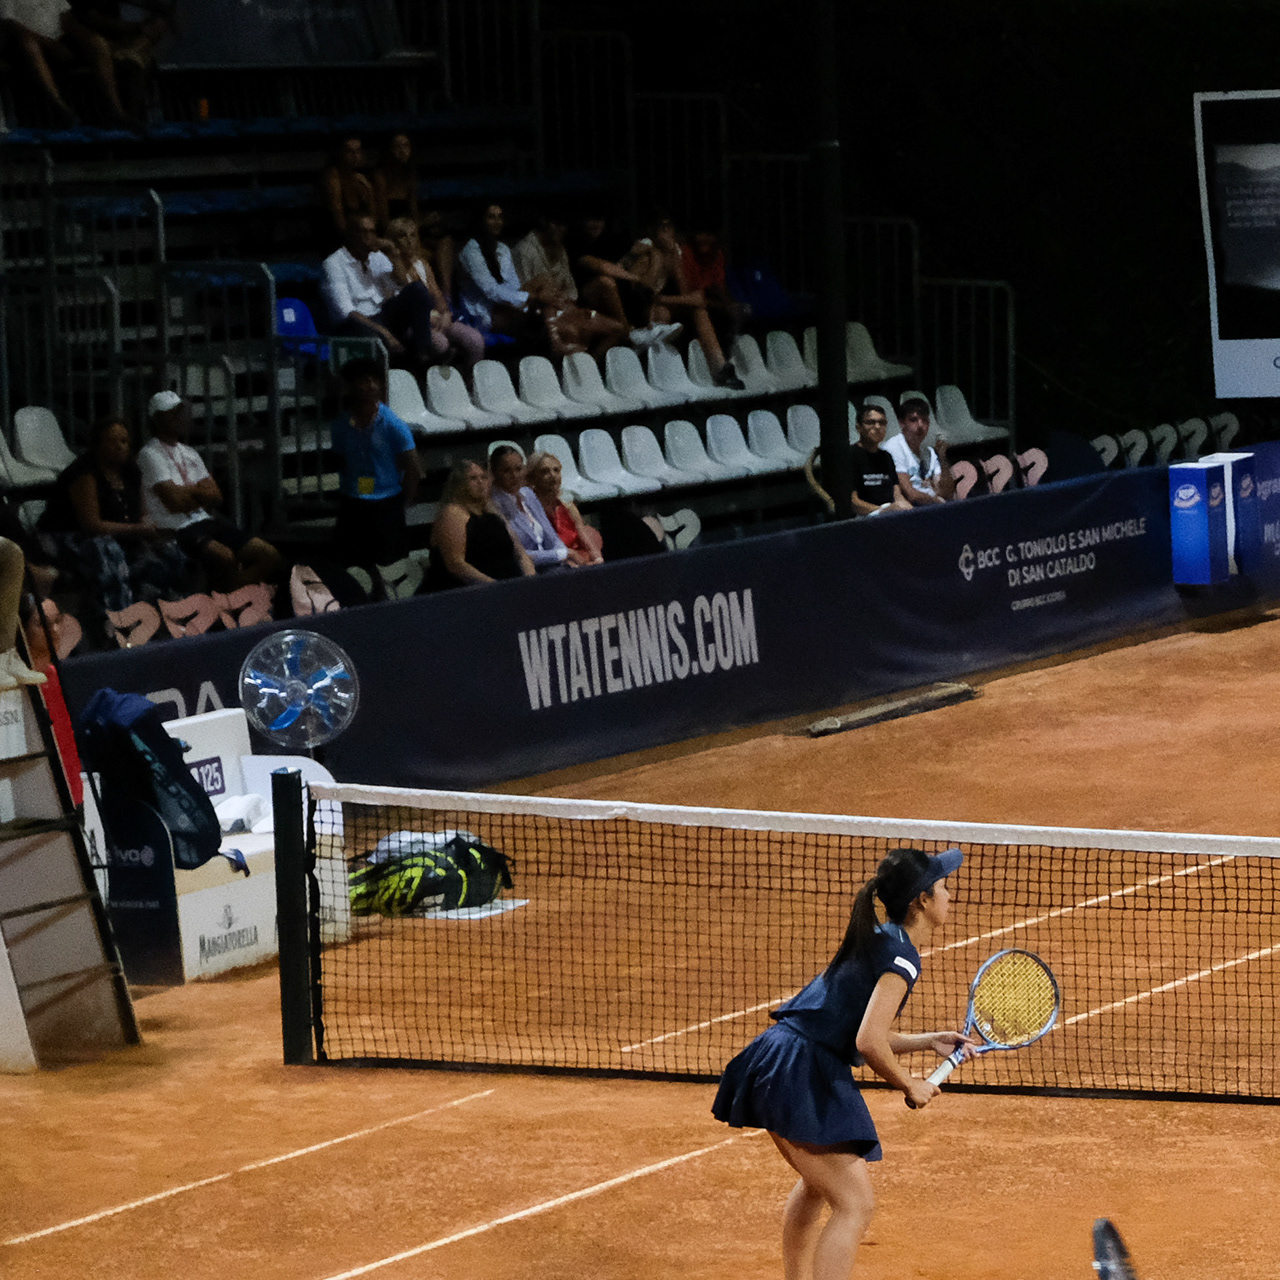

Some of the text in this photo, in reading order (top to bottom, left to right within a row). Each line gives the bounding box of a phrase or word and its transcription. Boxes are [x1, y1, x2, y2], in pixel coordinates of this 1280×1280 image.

[977, 518, 1147, 568] BCC G. TONIOLO E SAN MICHELE
[1007, 552, 1096, 587] DI SAN CATALDO
[517, 588, 760, 711] WTATENNIS.COM
[200, 762, 223, 793] 125
